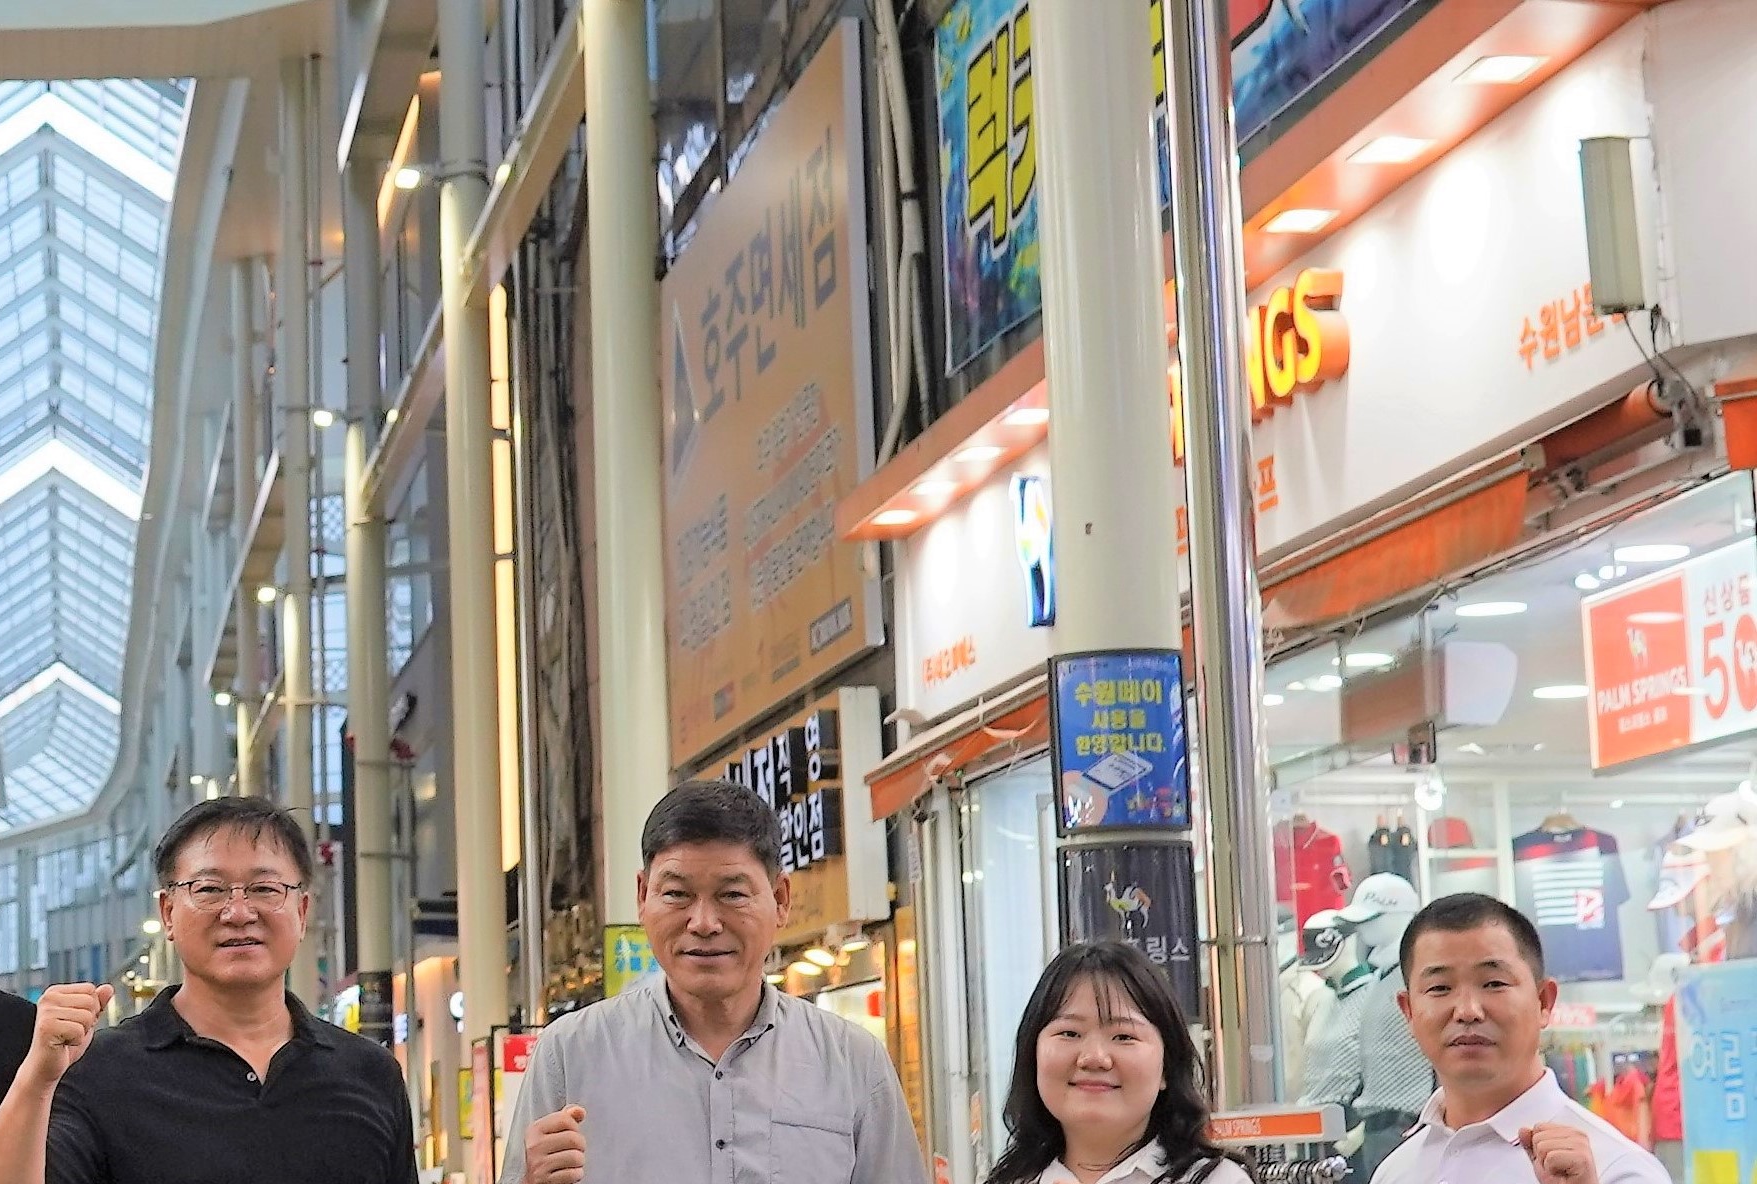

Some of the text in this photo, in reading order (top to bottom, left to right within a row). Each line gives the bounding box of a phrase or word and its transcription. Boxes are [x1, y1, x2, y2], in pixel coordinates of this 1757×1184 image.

[1075, 679, 1163, 707] 수원페이
[1596, 682, 1631, 717] PALM
[1092, 708, 1147, 730] 사용을
[1075, 732, 1167, 757] 환영합니다.
[1690, 1029, 1757, 1122] 여름
